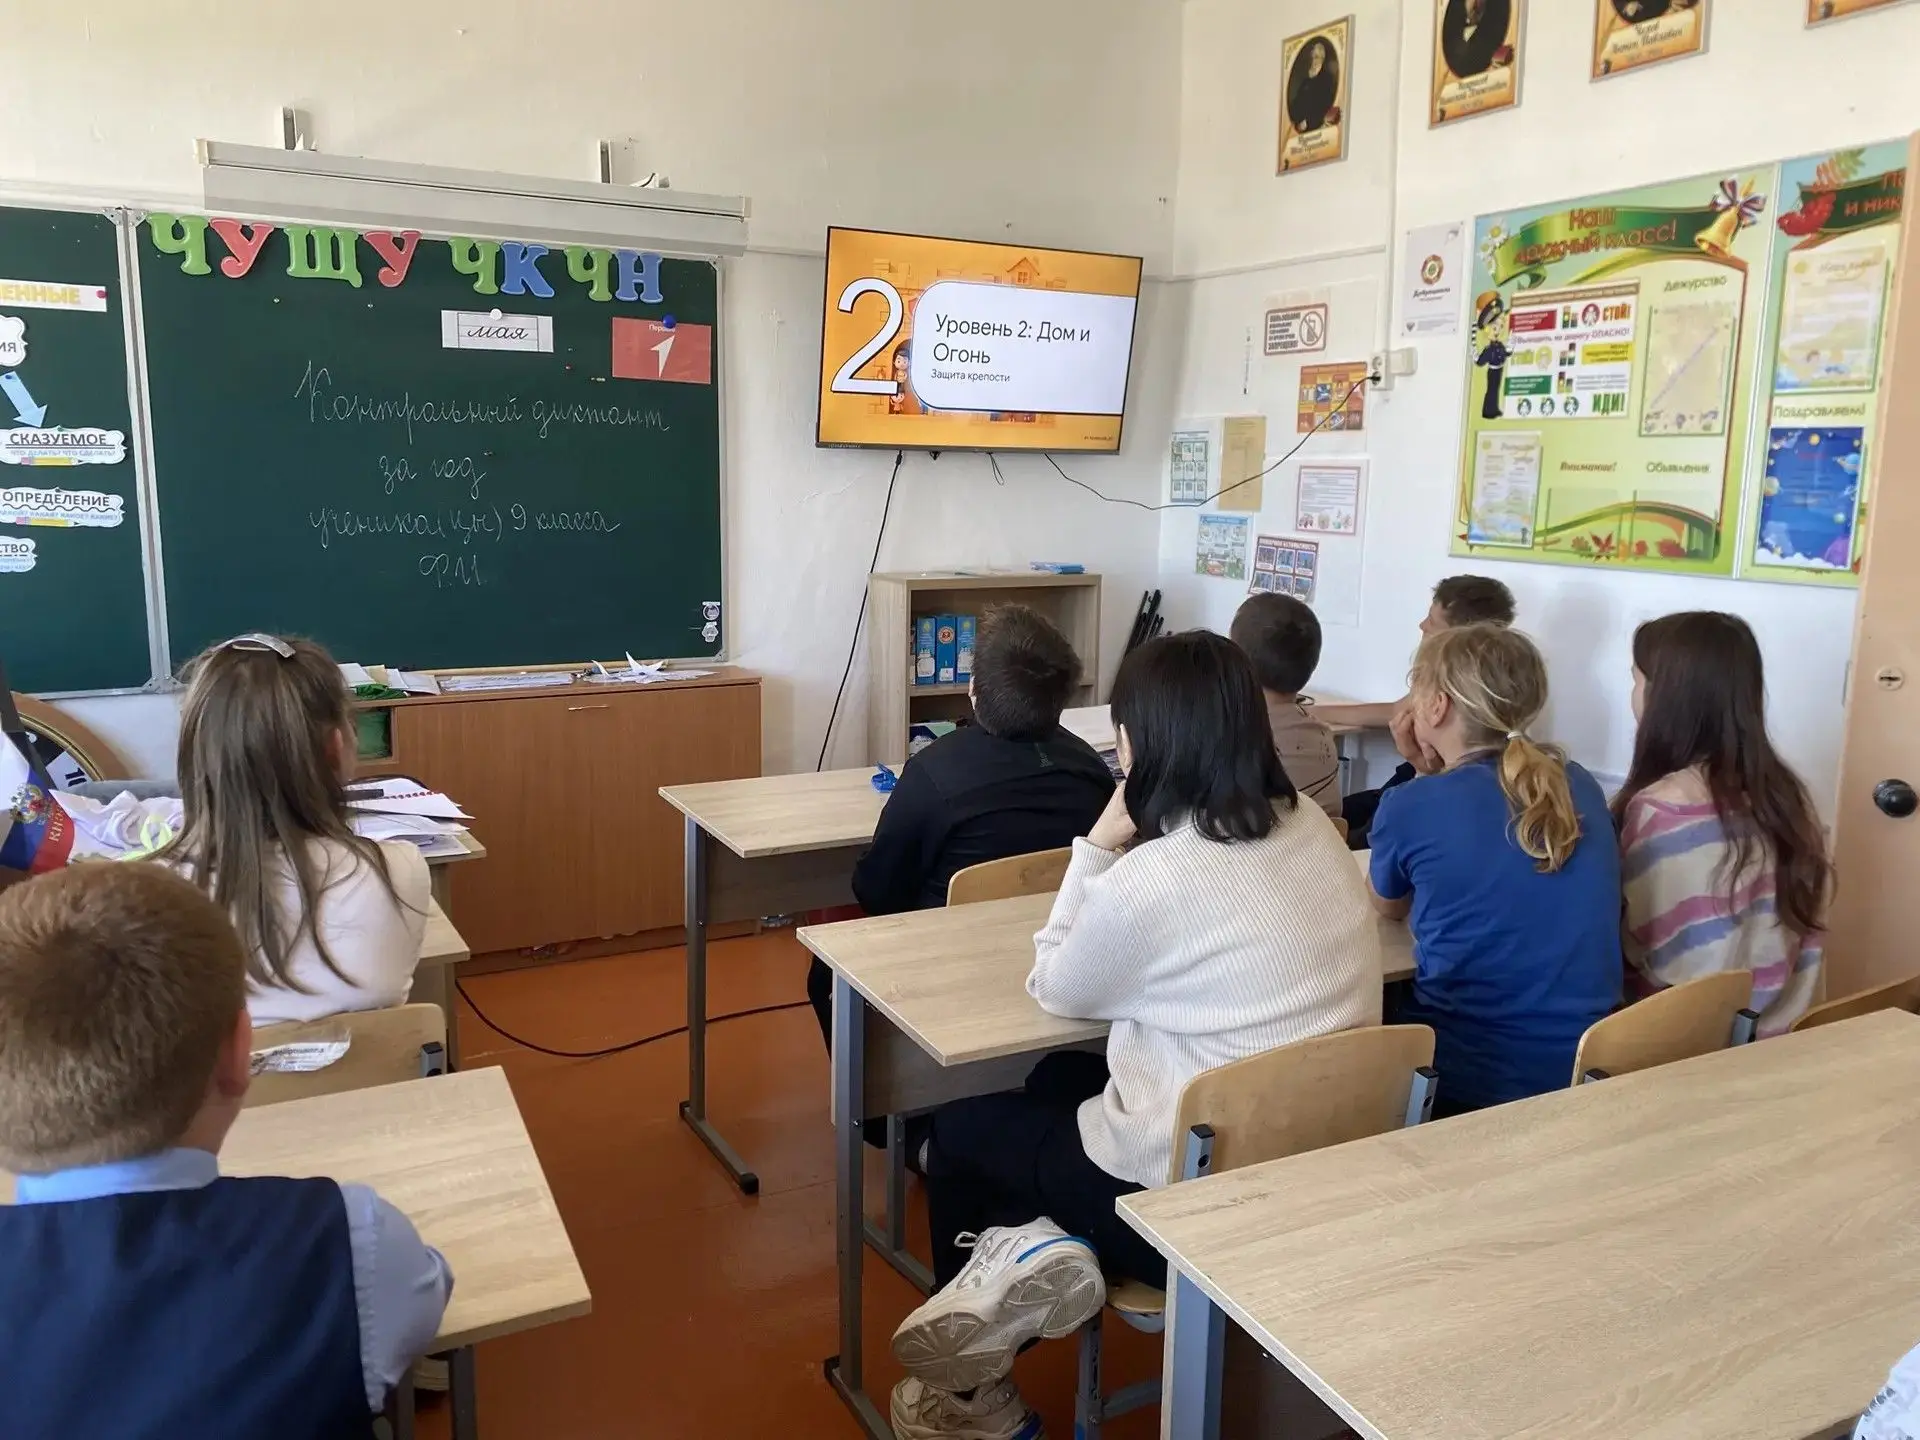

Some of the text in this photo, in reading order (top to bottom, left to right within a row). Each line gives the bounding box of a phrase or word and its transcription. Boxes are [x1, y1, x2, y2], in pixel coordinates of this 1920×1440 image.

[1664, 275, 1728, 292] Дежурство
[466, 324, 529, 341] мая
[831, 276, 905, 397] 2
[935, 313, 1091, 343] Уровень 2: Дом и
[933, 342, 991, 364] Огонь
[931, 369, 1011, 383] Защита крепости
[1591, 392, 1626, 416] ИДИ!
[10, 433, 107, 446] СКАЗУЕМОЕ
[379, 455, 418, 495] за
[3, 491, 110, 508] ОПРЕДЕЛЕНИЕ
[511, 502, 528, 531] 9
